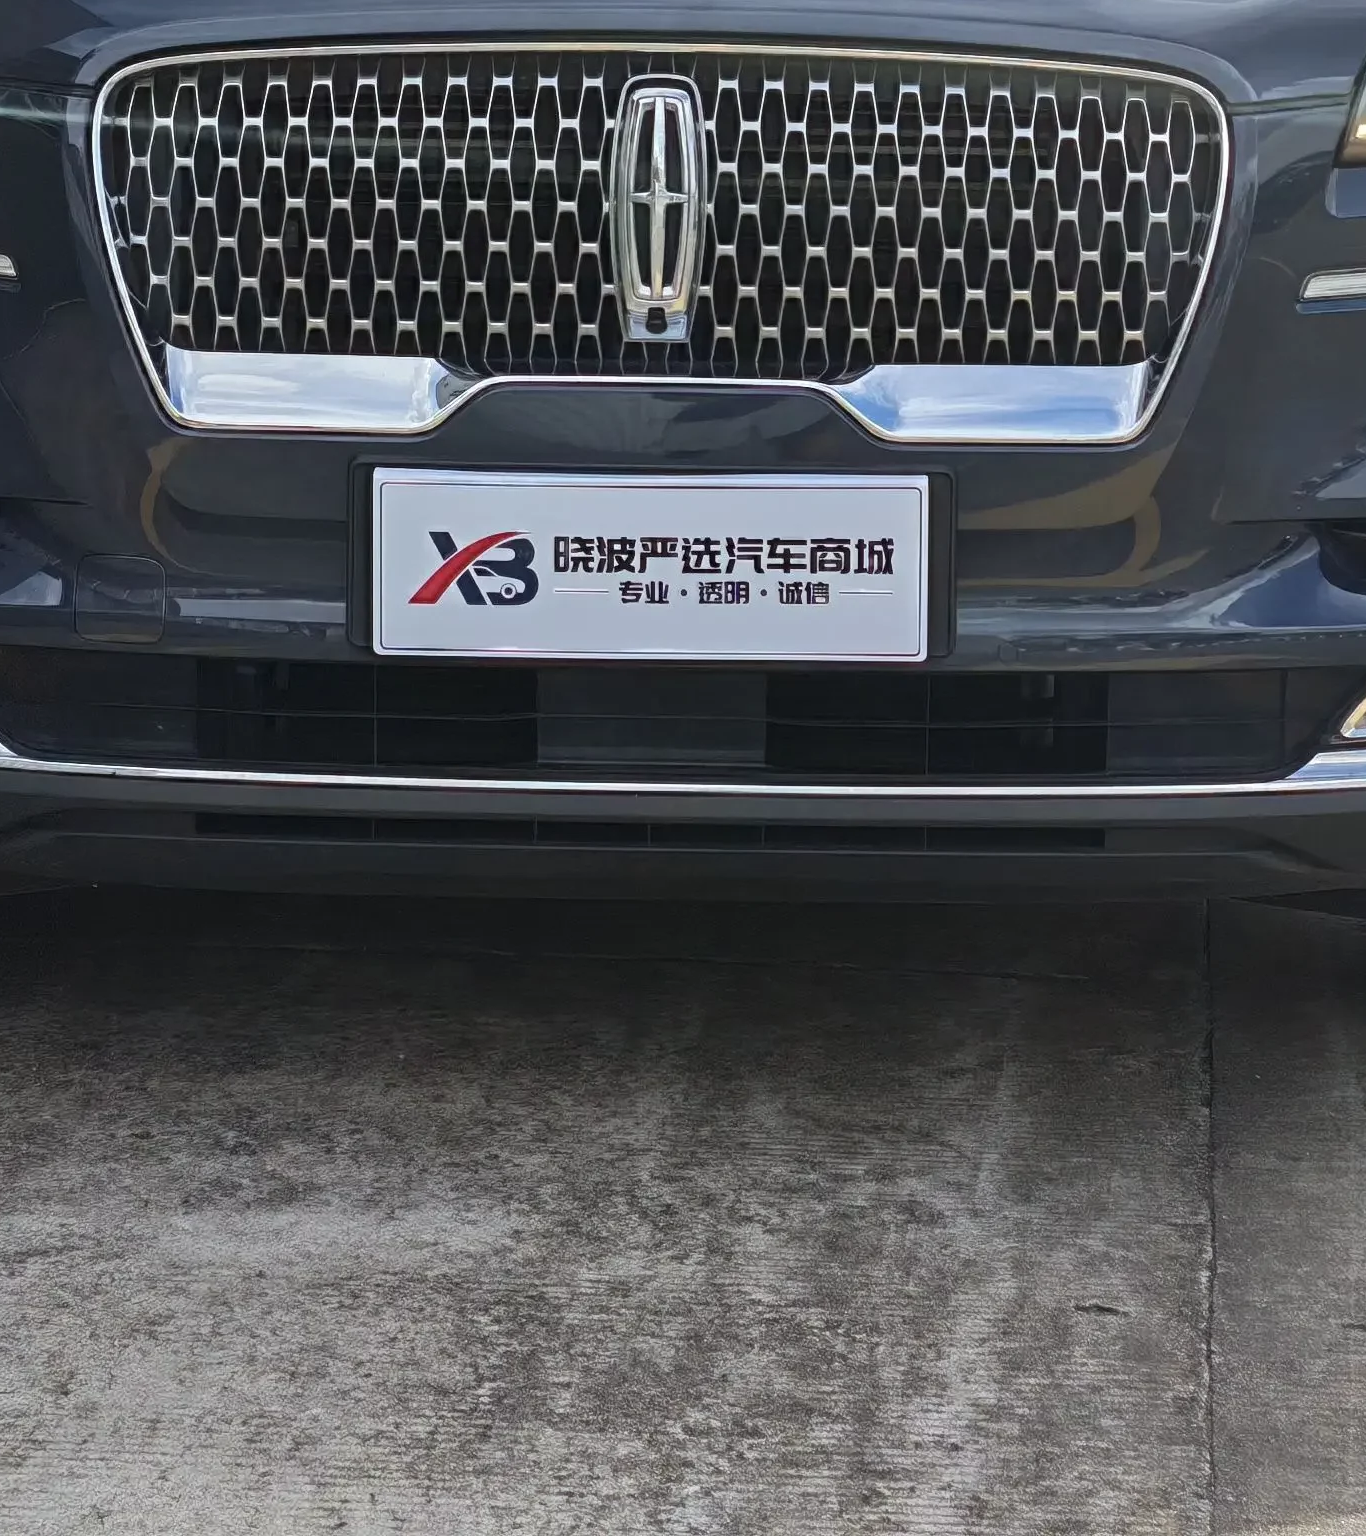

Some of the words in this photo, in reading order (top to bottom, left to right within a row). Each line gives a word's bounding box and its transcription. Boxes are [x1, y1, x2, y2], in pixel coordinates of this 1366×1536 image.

[553, 535, 895, 575] 晓波严选汽车商城
